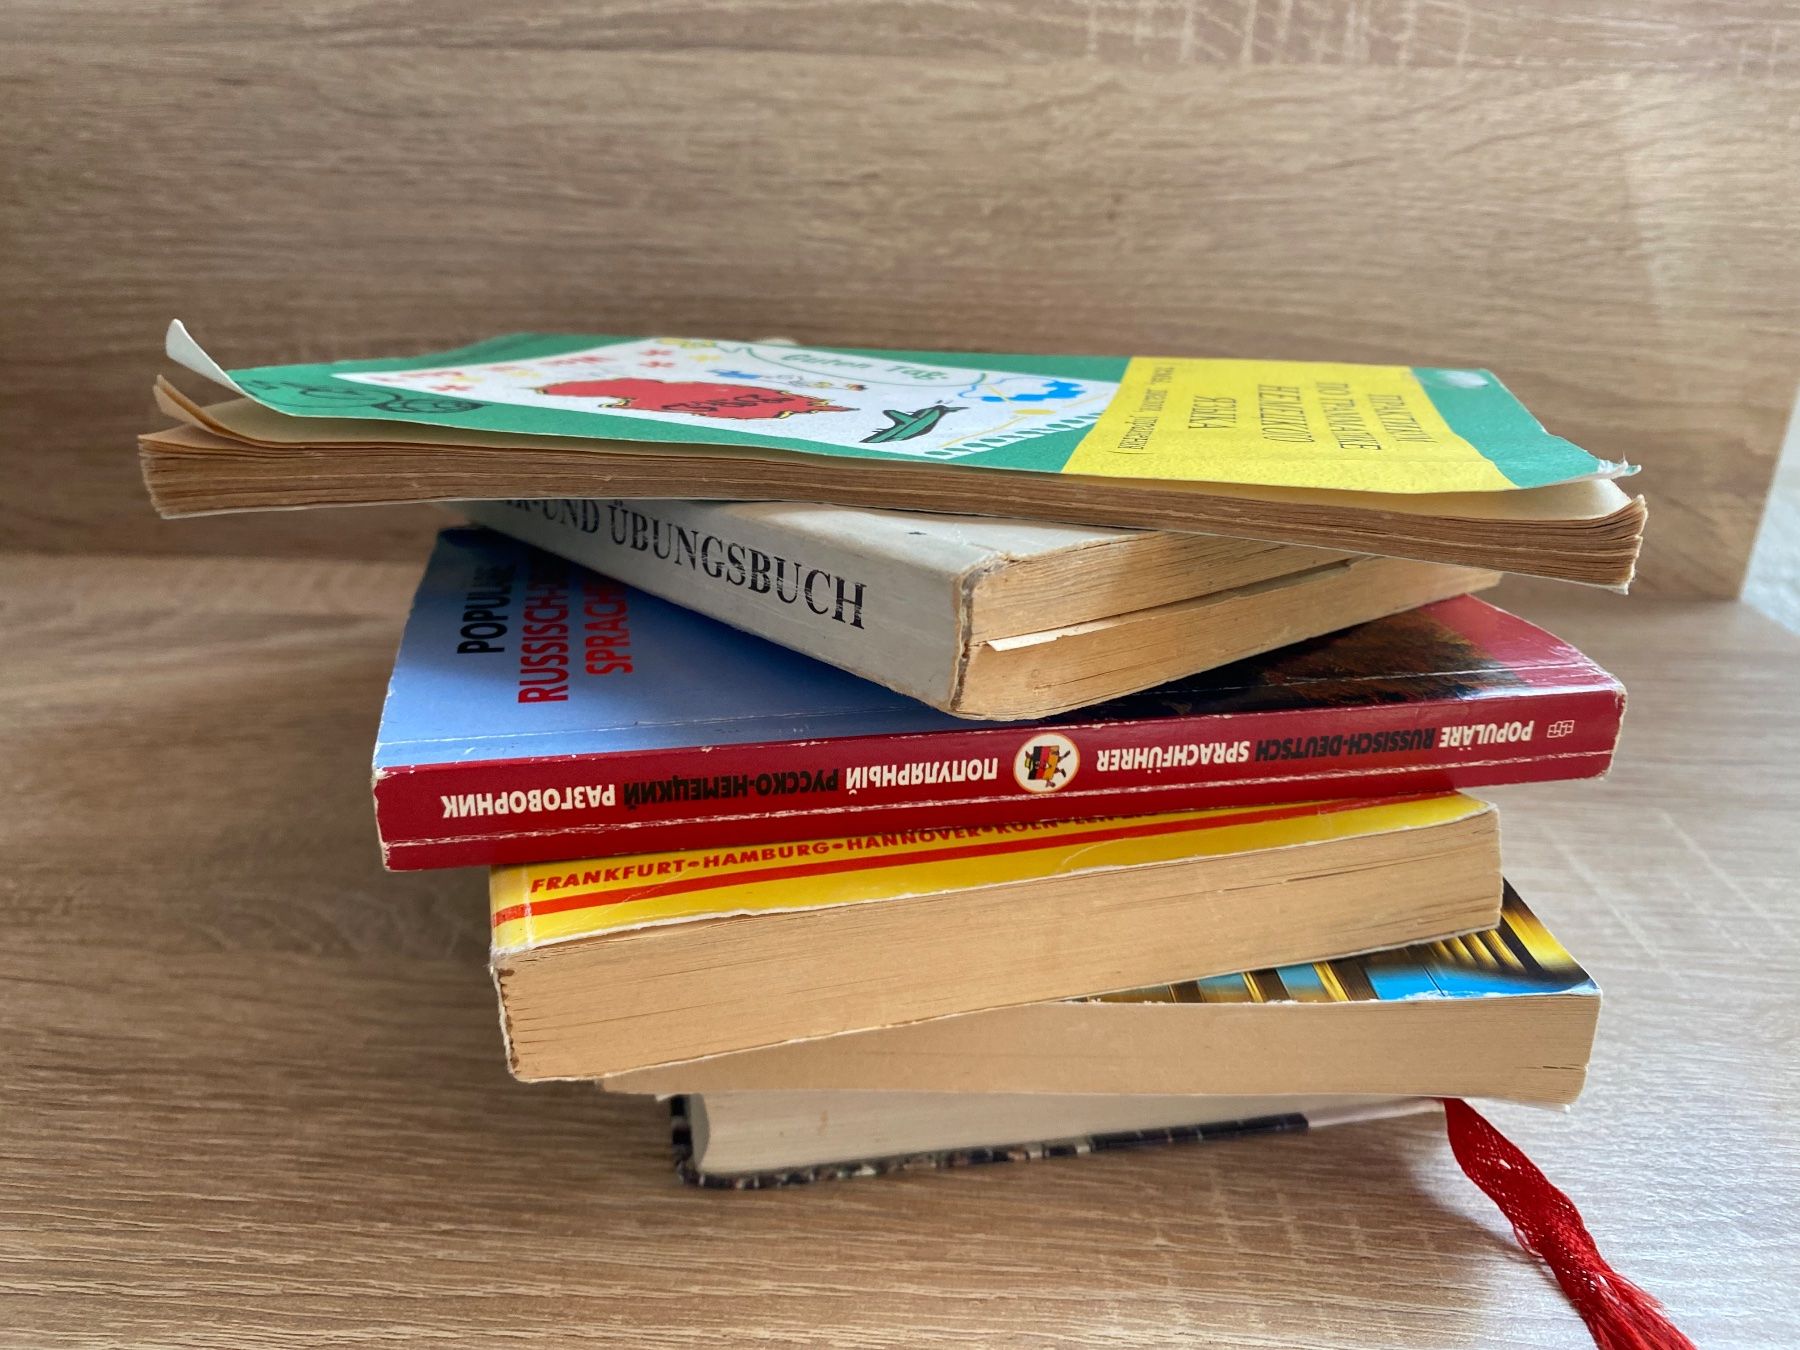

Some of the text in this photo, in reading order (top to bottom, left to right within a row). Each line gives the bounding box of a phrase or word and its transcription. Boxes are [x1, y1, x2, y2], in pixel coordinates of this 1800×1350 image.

[1188, 395, 1238, 429] ЯЗЫКА
[1257, 384, 1315, 442] НЕМЕЦКОГО
[606, 499, 867, 630] ÜBUNGSBUCH
[1096, 720, 1535, 775] POPULÄRE RUSSISCH-DEUTSCH SPRACHFÜHRER
[442, 757, 1000, 819] ПОПУЛЯРНЫЙ РУССКО-НЕМЕЦКИЙ РАЗГОВОРНИК
